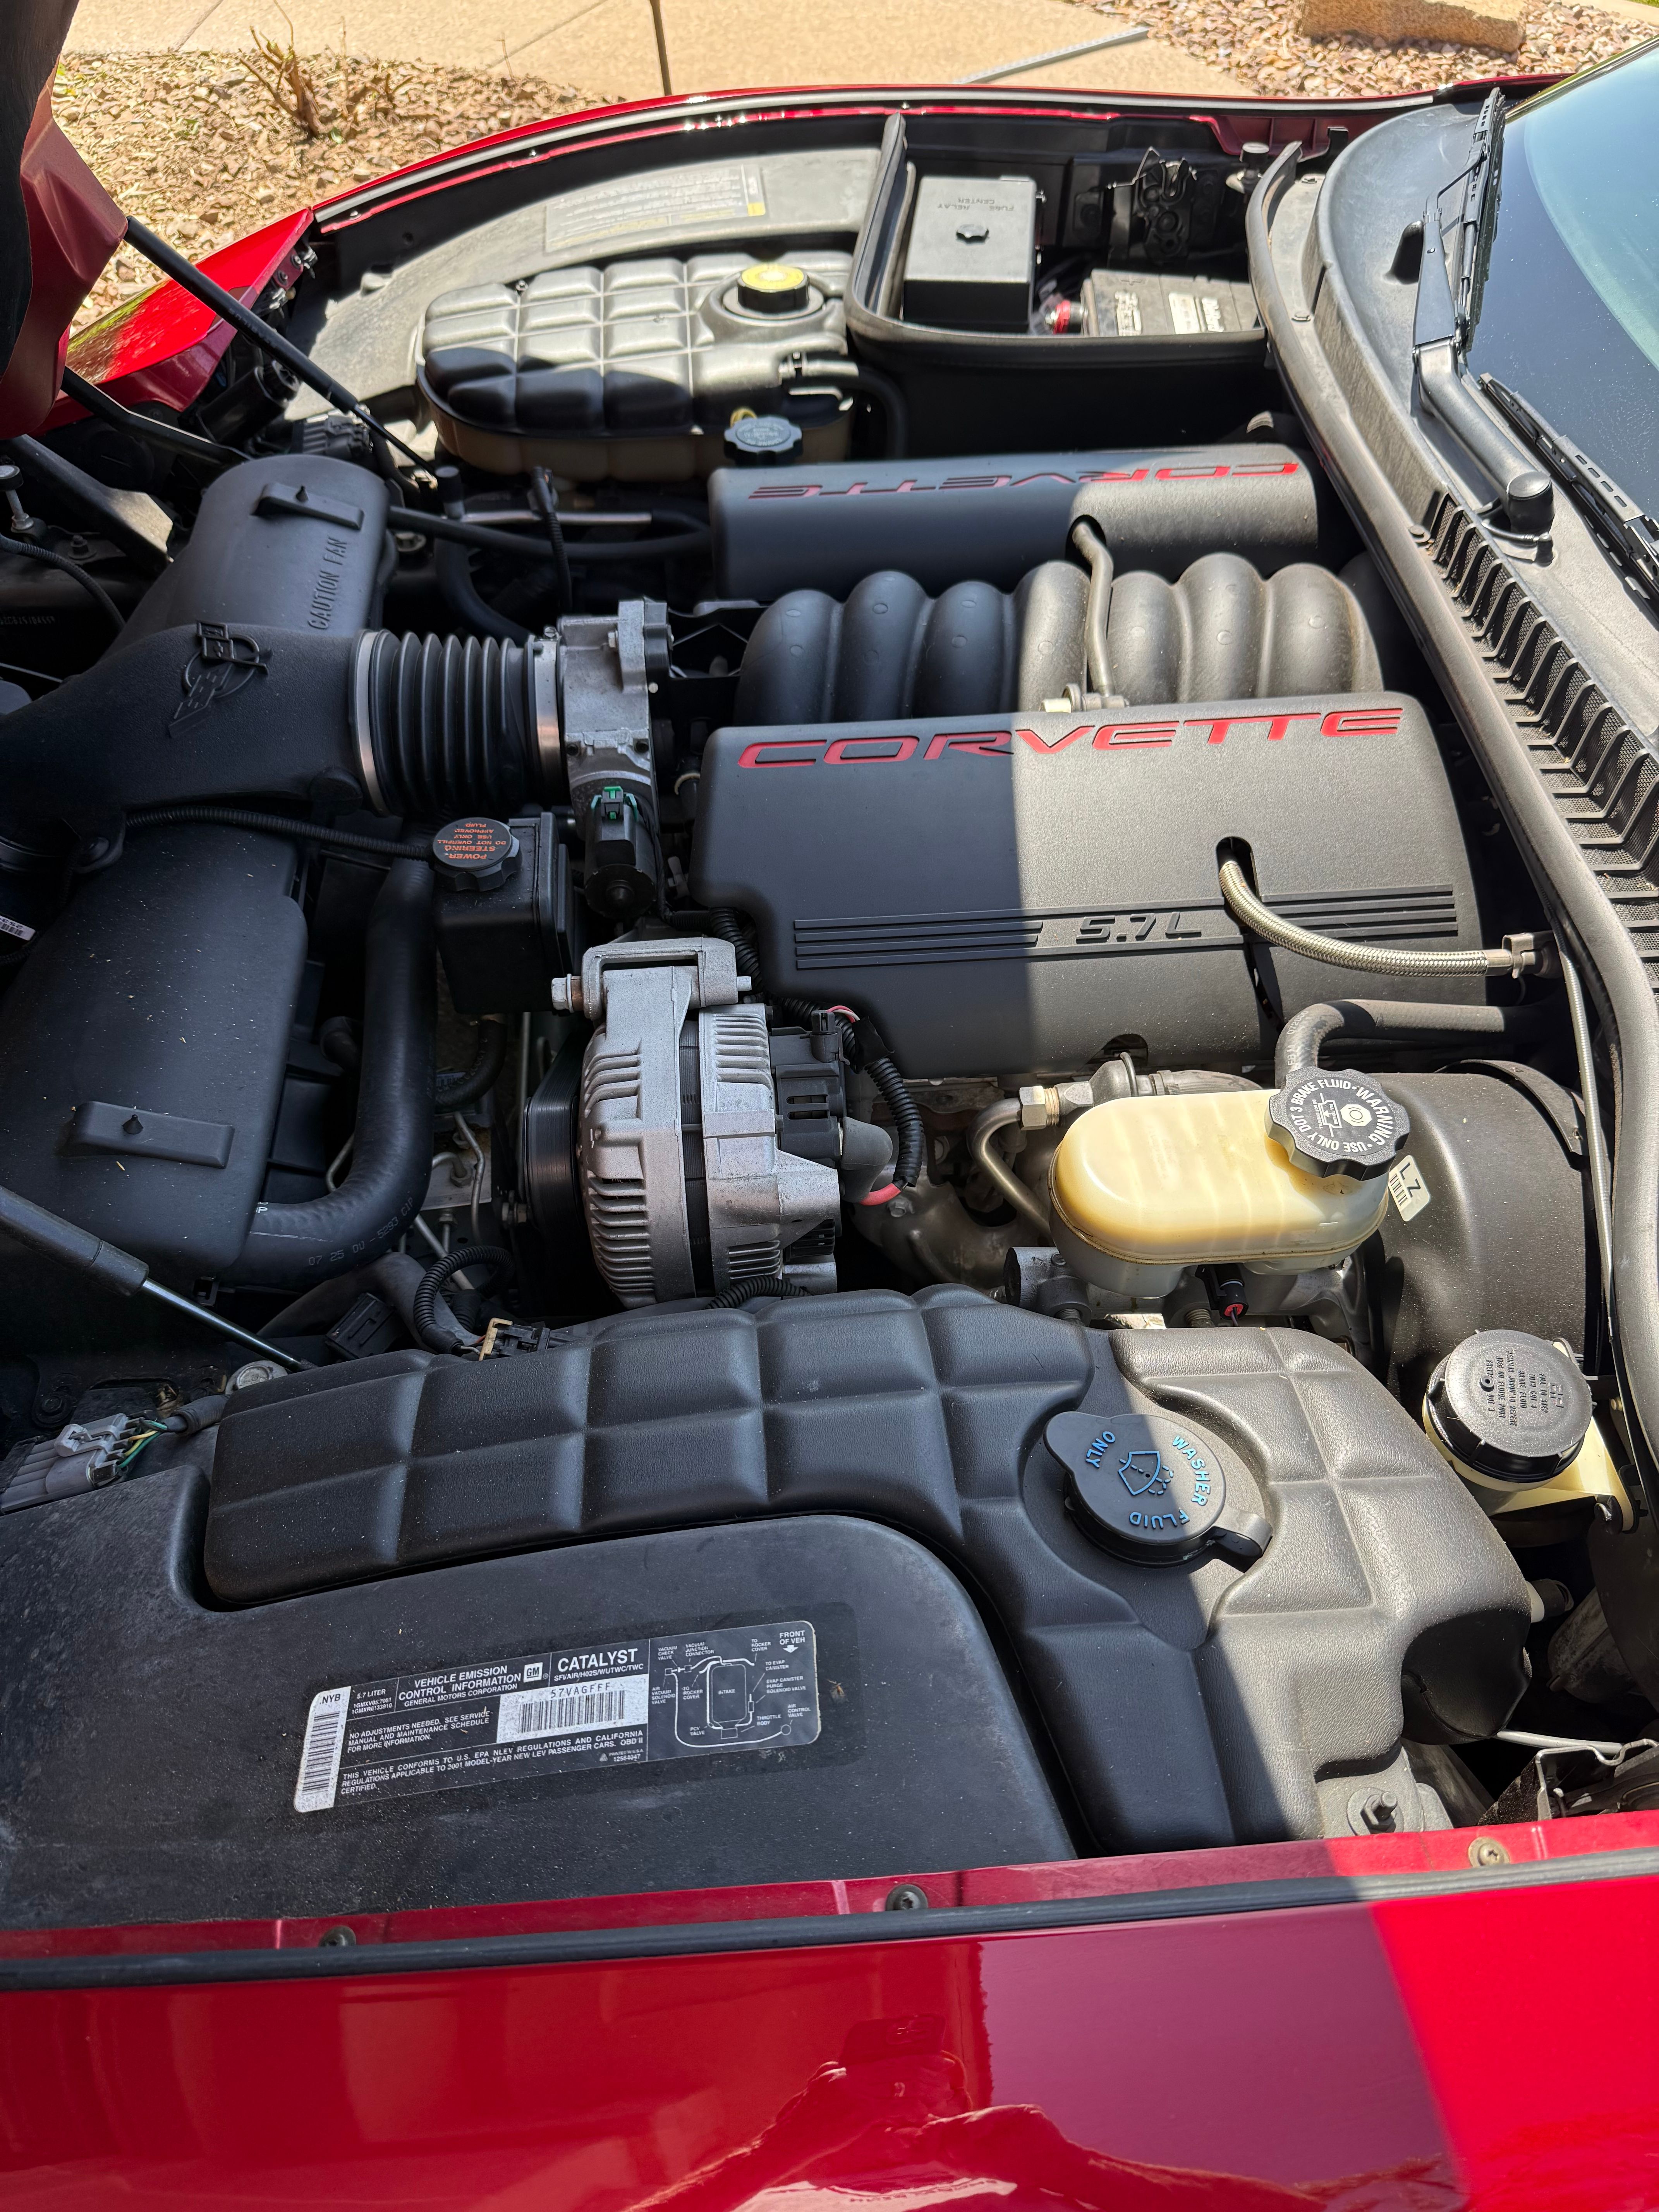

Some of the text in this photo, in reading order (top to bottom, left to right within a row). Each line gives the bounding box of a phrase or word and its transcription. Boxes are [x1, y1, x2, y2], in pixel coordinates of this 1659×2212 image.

[749, 462, 1299, 500] CORVETTE
[307, 537, 347, 630] CAUTION FAN
[737, 708, 1403, 769] CORVETTE
[1075, 911, 1202, 943] 5.7L
[1291, 1079, 1351, 1105] BRAKE FLUID
[1290, 1115, 1312, 1133] DOT
[1356, 1087, 1393, 1146] WARNING
[1307, 1132, 1340, 1151] ONLY
[1344, 1142, 1367, 1152] USE
[309, 1255, 322, 1266] 07
[330, 1249, 344, 1262] 25
[1085, 1431, 1116, 1468] ONLY
[1173, 1435, 1211, 1506] WASHER
[1129, 1507, 1190, 1528] FLUID
[780, 1630, 805, 1638] FRONT
[526, 1667, 539, 1676] GM
[558, 1648, 637, 1672] CATALYST
[398, 1673, 521, 1700] CONTROL INFORMATION
[414, 1665, 507, 1688] VEHICLE EMISSION
[404, 1683, 517, 1707] GENERAL MOTORS CORPORATION
[551, 1682, 610, 1698] 57VAGFFF
[349, 1736, 376, 1745] MANUAL
[397, 1724, 448, 1737] MAINTENANCE
[451, 1717, 489, 1729] SCHEDULE
[361, 1724, 409, 1737] ADJUSTMENTS
[460, 1711, 489, 1720] SERVICE
[362, 1741, 382, 1750] MORE
[363, 1766, 393, 1776] VEHICLE
[398, 1759, 439, 1771] CONFORMS
[517, 1739, 571, 1752] REGULATIONS
[596, 1730, 642, 1741] CALIFORNIA
[342, 1774, 389, 1786] REGULATIONS
[391, 1766, 434, 1779] APPLICABLE
[465, 1755, 512, 1766] MODEL-YEAR
[548, 1744, 591, 1755] PASSENGER
